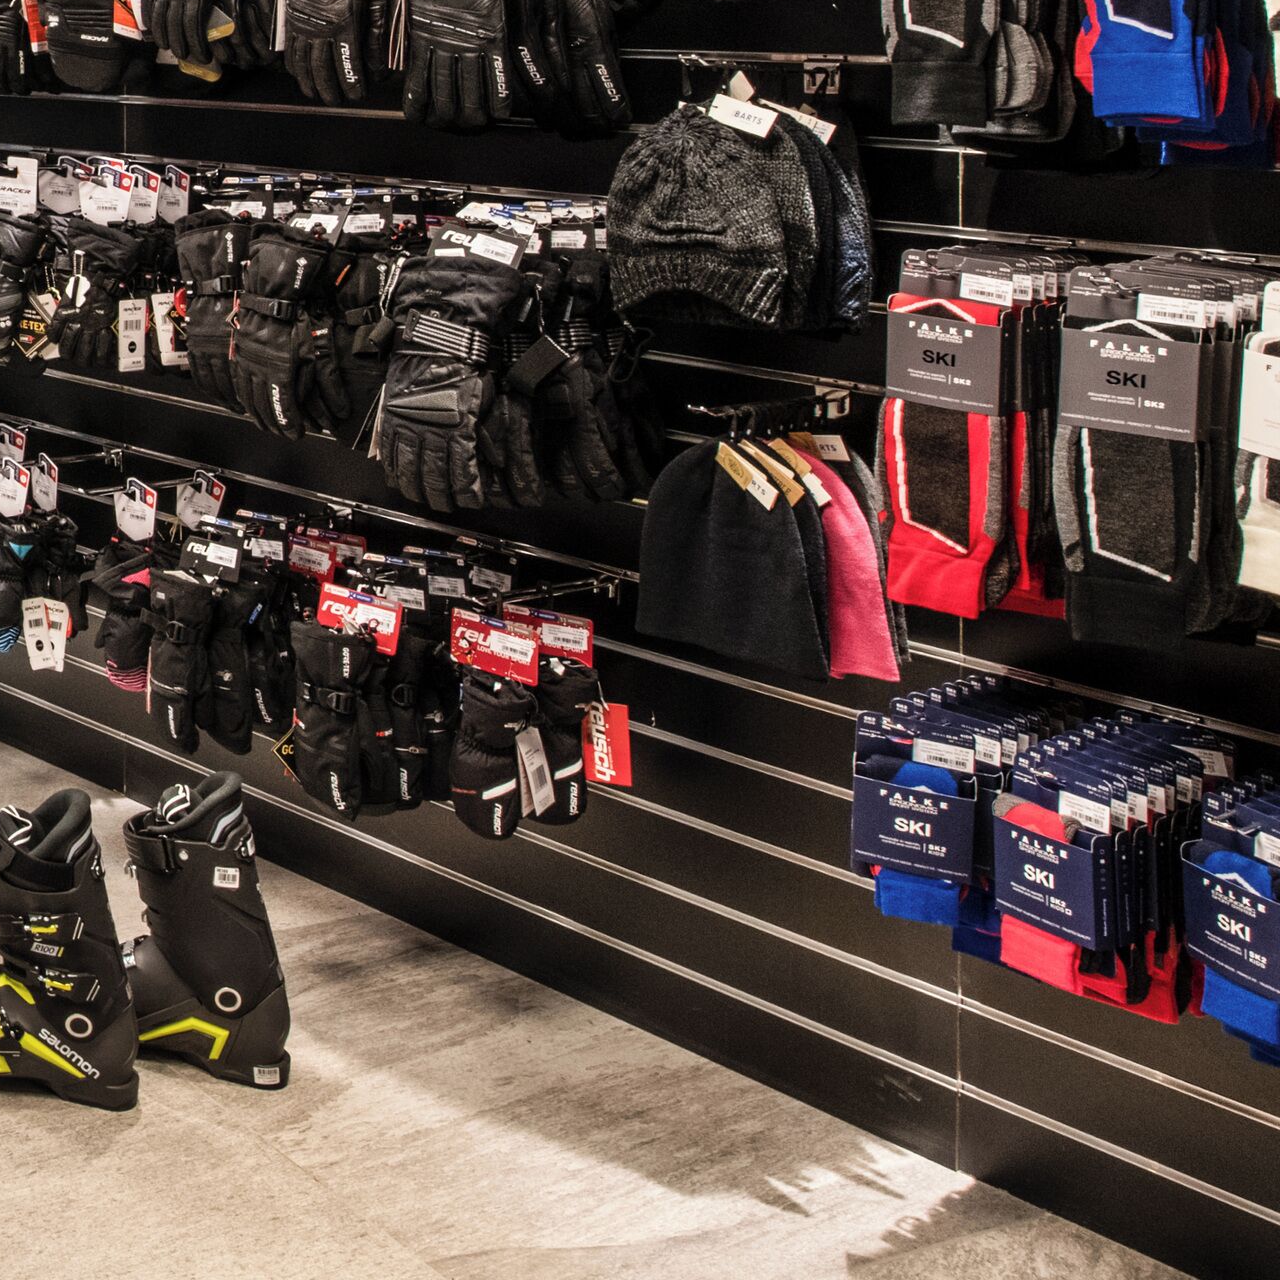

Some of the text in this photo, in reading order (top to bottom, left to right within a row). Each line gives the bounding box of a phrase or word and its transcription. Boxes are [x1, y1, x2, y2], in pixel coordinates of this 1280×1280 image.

[340, 41, 359, 83] reusch
[518, 45, 547, 86] reusch
[493, 55, 510, 98] reusch
[595, 63, 622, 102] reusch
[733, 110, 763, 126] BARTS
[0, 186, 32, 195] RACER
[19, 320, 47, 332] E-TEX
[908, 320, 973, 338] FALKE
[922, 349, 956, 367] SKI
[1089, 339, 1168, 356] FALKE
[953, 377, 972, 386] SK2
[1106, 370, 1146, 389] SKI
[271, 384, 288, 426] reusch
[1143, 399, 1165, 410] SK2
[342, 646, 350, 679] GORE-TEX
[254, 687, 272, 724] reusch
[589, 701, 616, 782] reusch
[330, 770, 347, 811] reusch
[400, 767, 412, 801] reusch
[569, 781, 580, 816] reusch
[880, 788, 949, 810] FALKE
[494, 802, 504, 836] reusch
[894, 817, 932, 838] SKI
[928, 844, 947, 853] SK2
[1011, 830, 1069, 860] FALKE
[1023, 863, 1055, 890] SKI
[1050, 896, 1066, 908] SK2
[1203, 877, 1267, 914] FALKE
[1217, 913, 1251, 943] SKI
[33, 944, 56, 954] R100
[1249, 950, 1268, 965] SK2
